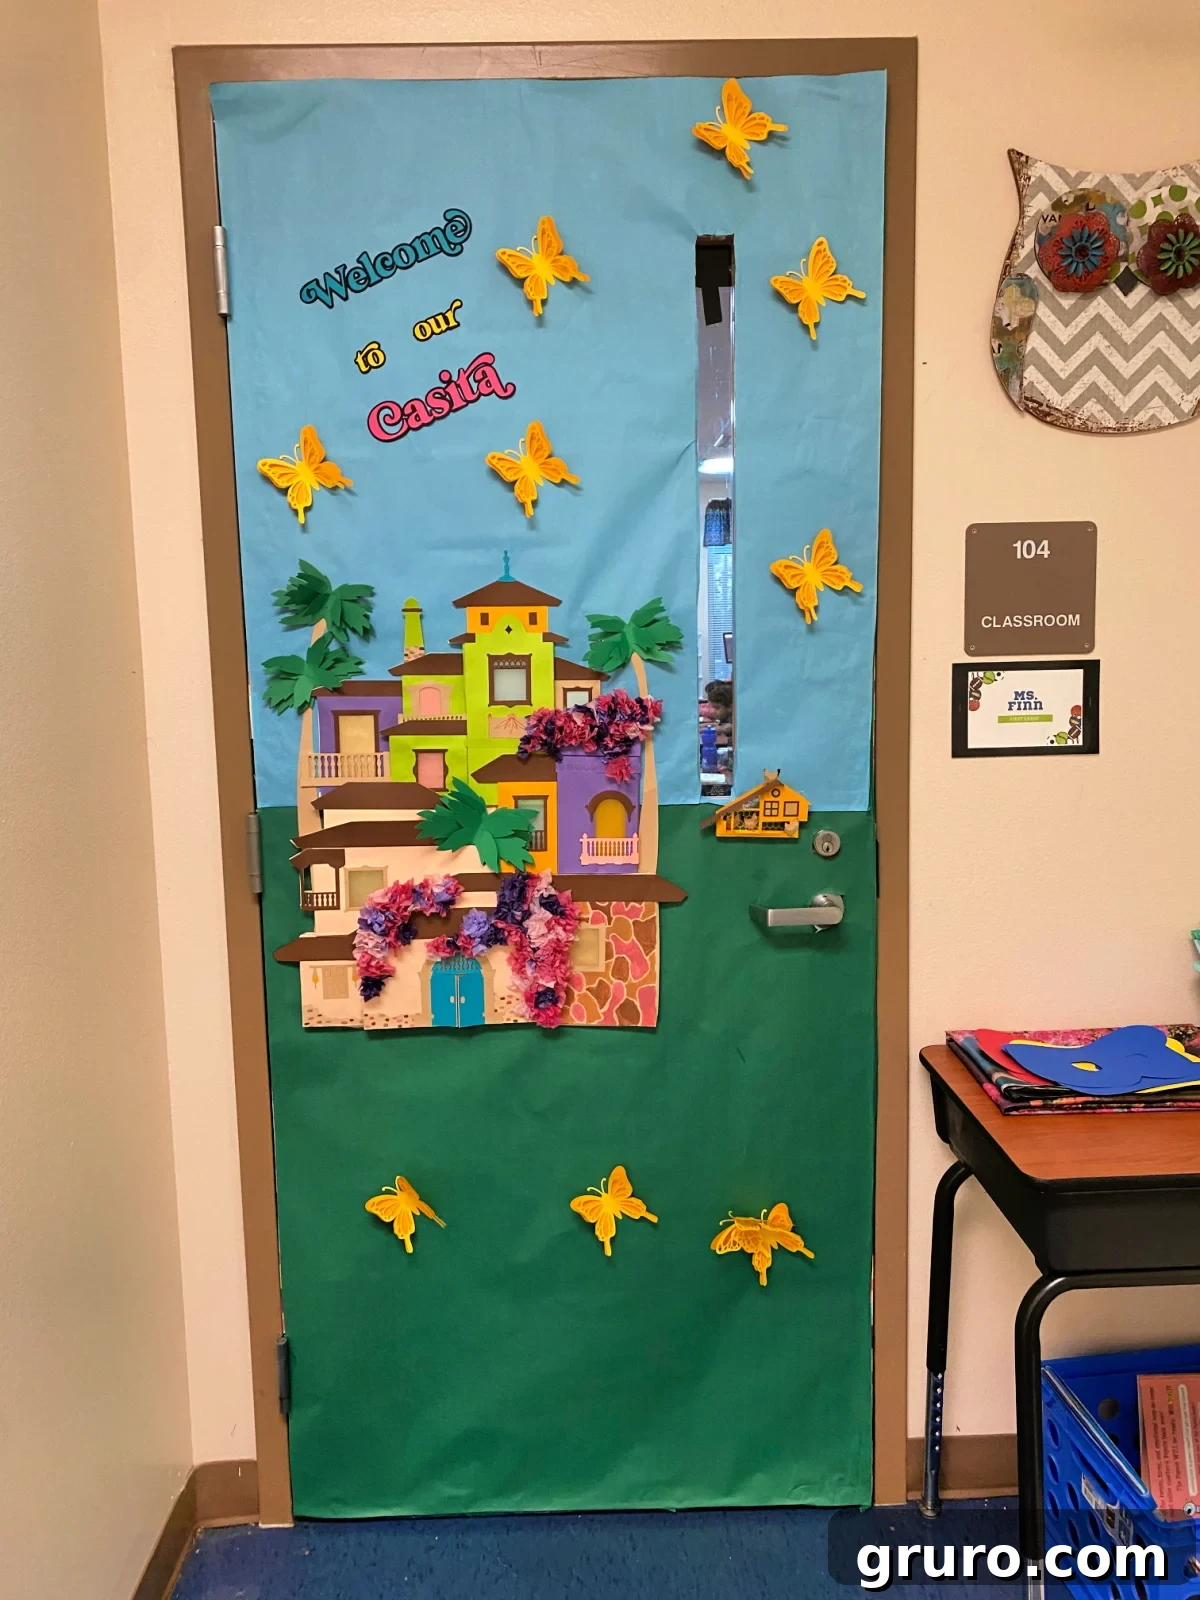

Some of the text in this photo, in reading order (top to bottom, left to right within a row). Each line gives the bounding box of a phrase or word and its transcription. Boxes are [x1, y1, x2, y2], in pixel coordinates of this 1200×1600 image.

[300, 208, 472, 309] Welcome
[354, 299, 463, 374] to our
[367, 352, 516, 442] Casita
[1013, 540, 1050, 559] 104
[981, 614, 1080, 629] CLASSROOM
[1014, 691, 1038, 700] MS.
